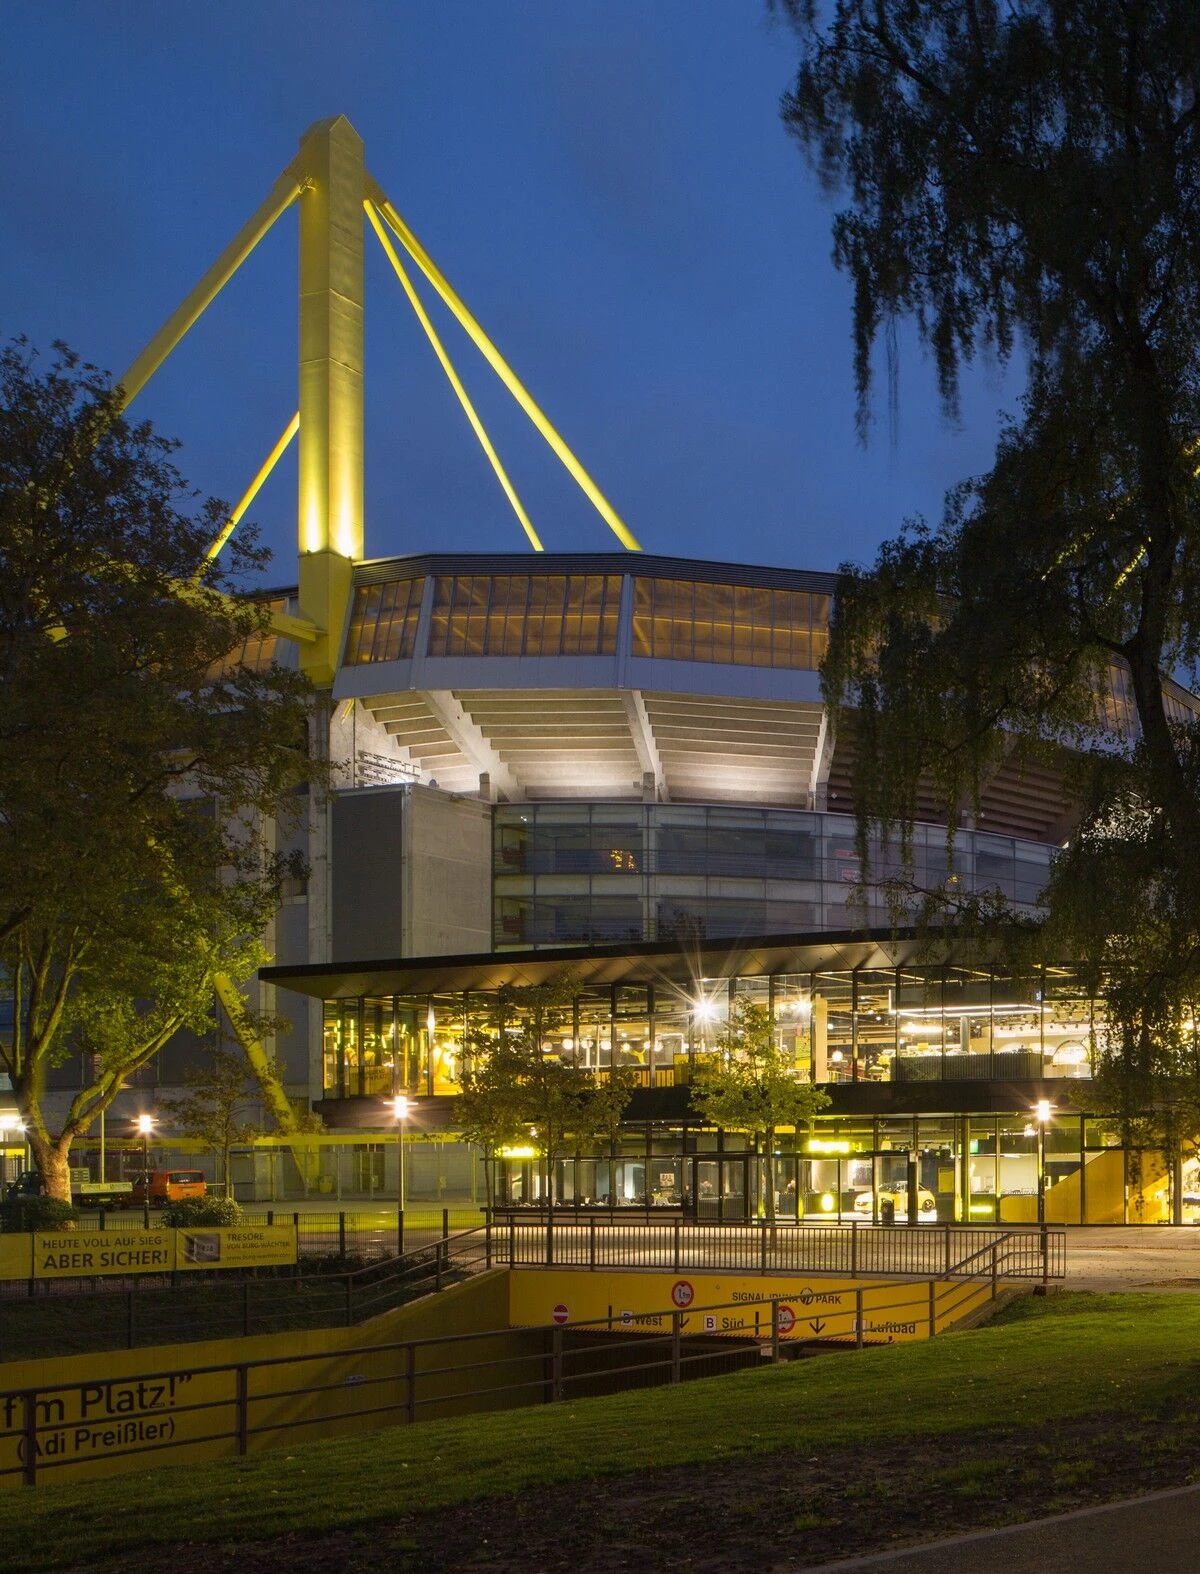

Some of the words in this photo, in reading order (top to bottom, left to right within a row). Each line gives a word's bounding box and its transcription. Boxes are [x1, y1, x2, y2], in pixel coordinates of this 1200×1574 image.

[42, 1239, 79, 1249] HEUTE
[83, 1238, 110, 1248] VOLL
[114, 1237, 136, 1247] AUF
[139, 1236, 162, 1246] SIEG
[227, 1232, 264, 1241] TRESORE
[43, 1253, 93, 1269] ABER
[100, 1250, 168, 1267] SICHER!
[816, 1295, 841, 1304] PARK
[706, 1318, 714, 1328] B
[721, 1317, 744, 1329] Süd
[75, 1417, 175, 1451] Preißler)
